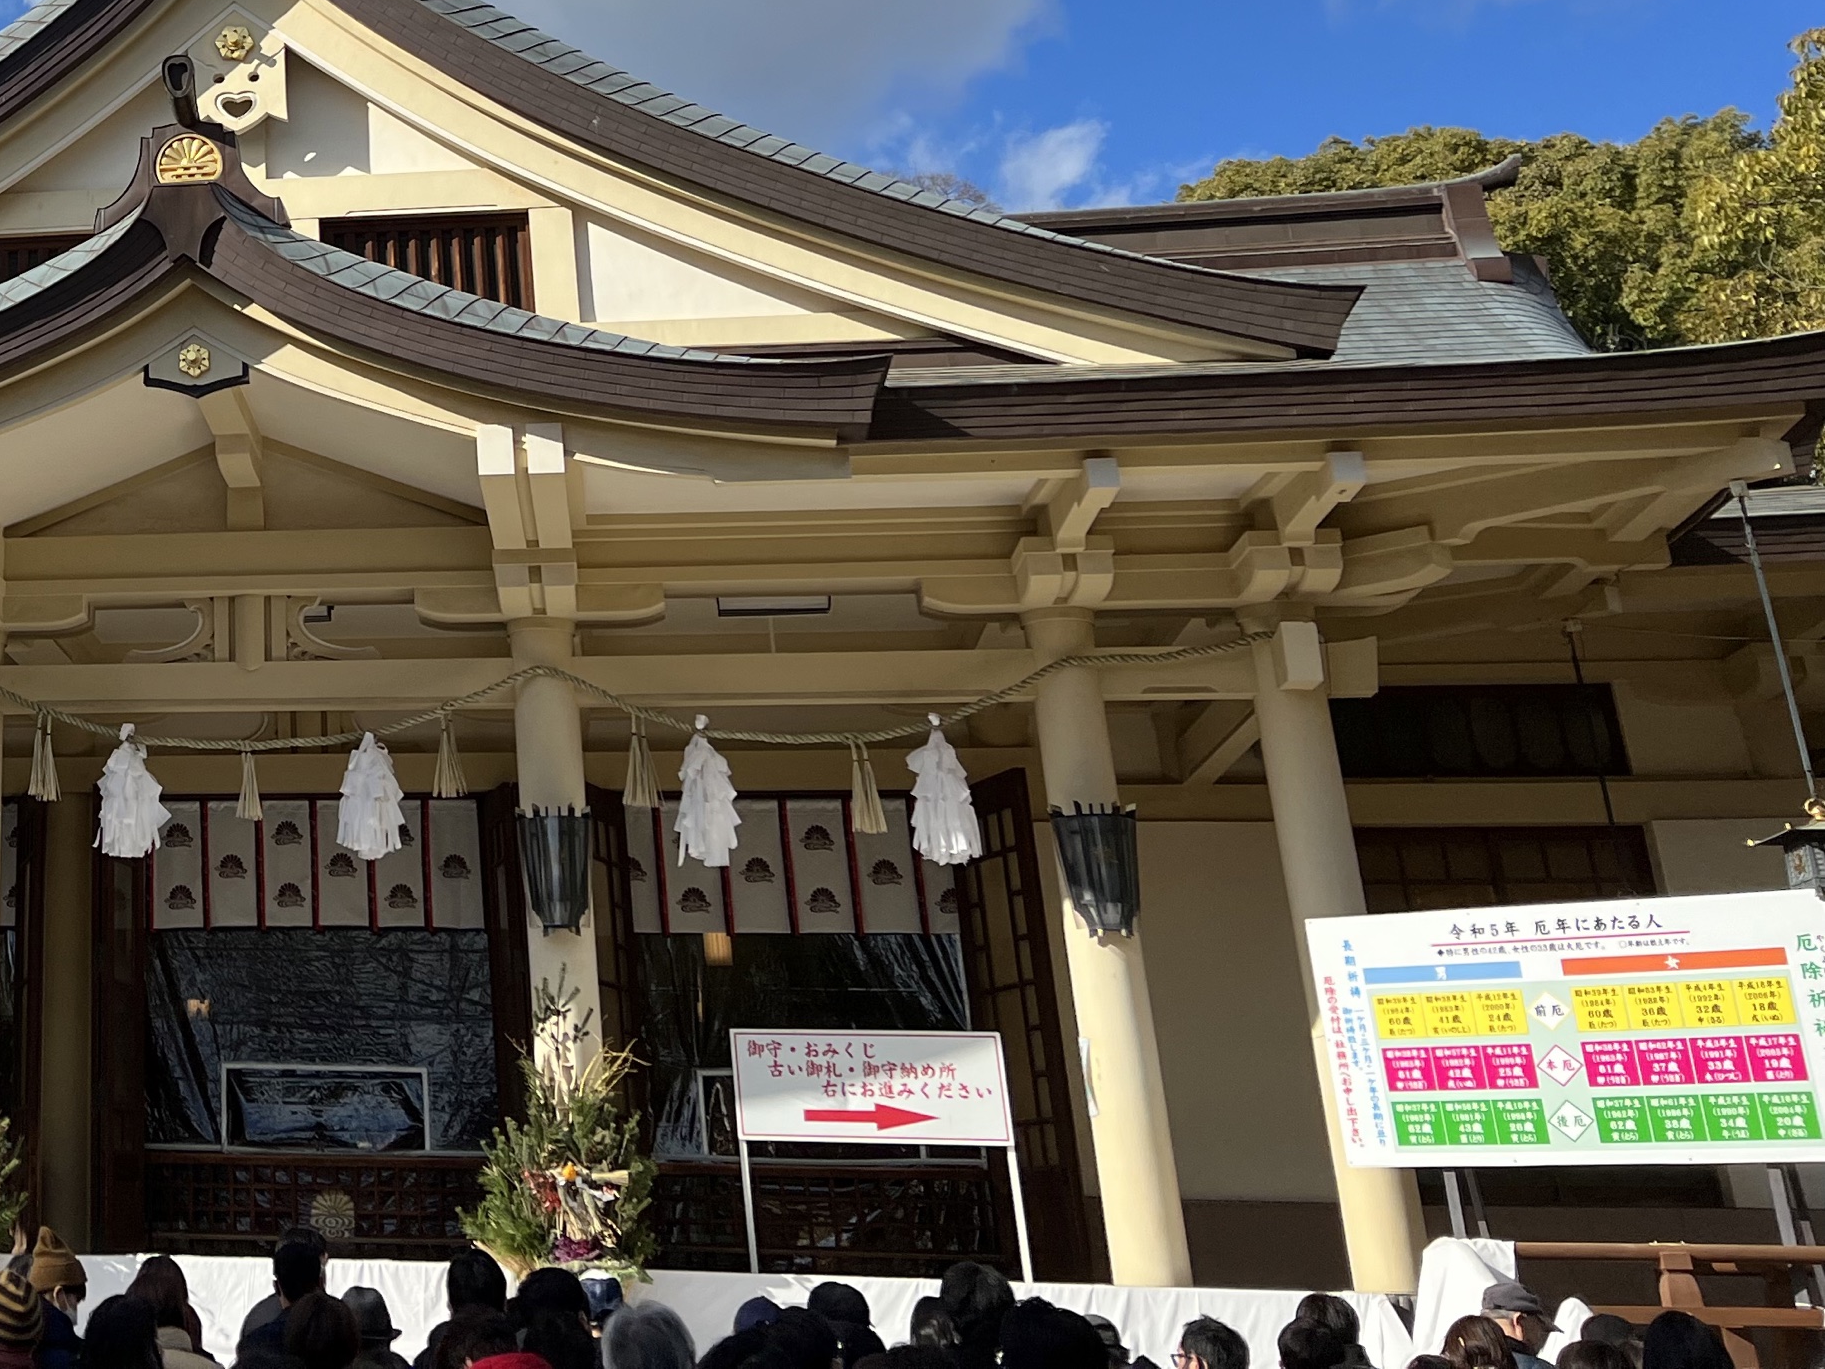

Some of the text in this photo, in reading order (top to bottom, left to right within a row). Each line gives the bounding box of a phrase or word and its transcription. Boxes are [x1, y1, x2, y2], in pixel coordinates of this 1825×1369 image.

[1448, 913, 1664, 941] 令和5年 厄年にあたる人
[1534, 1004, 1565, 1018] 前厄
[1696, 1004, 1723, 1014] 32歳
[1752, 1001, 1779, 1011] 18歳
[746, 1038, 877, 1059] 御守・おみくじ
[767, 1060, 958, 1082] 古い御札・御守納め所
[1546, 1058, 1576, 1072] 本厄
[821, 1081, 994, 1100] 右にお進みください
